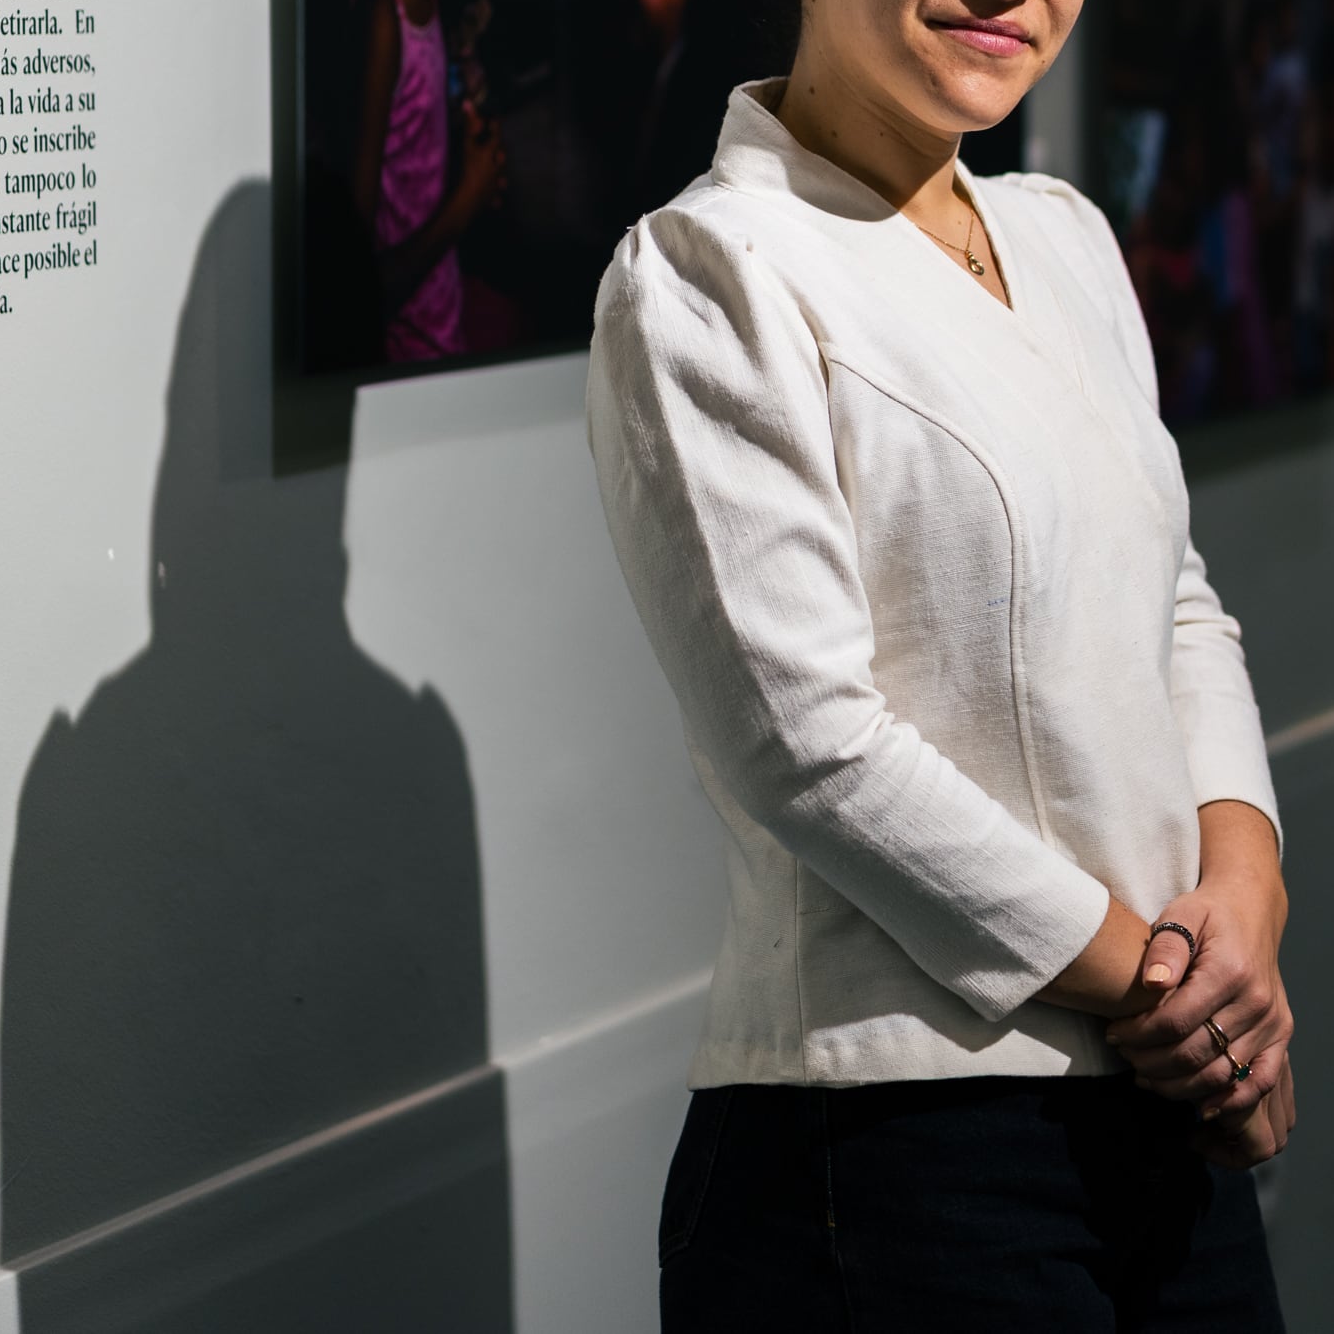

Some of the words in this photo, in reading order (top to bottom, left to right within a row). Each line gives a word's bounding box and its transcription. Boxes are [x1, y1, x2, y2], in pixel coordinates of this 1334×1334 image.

[22, 47, 96, 75] adversos,
[12, 134, 29, 155] se
[33, 124, 96, 153] inscribe
[56, 200, 97, 236] frágil
